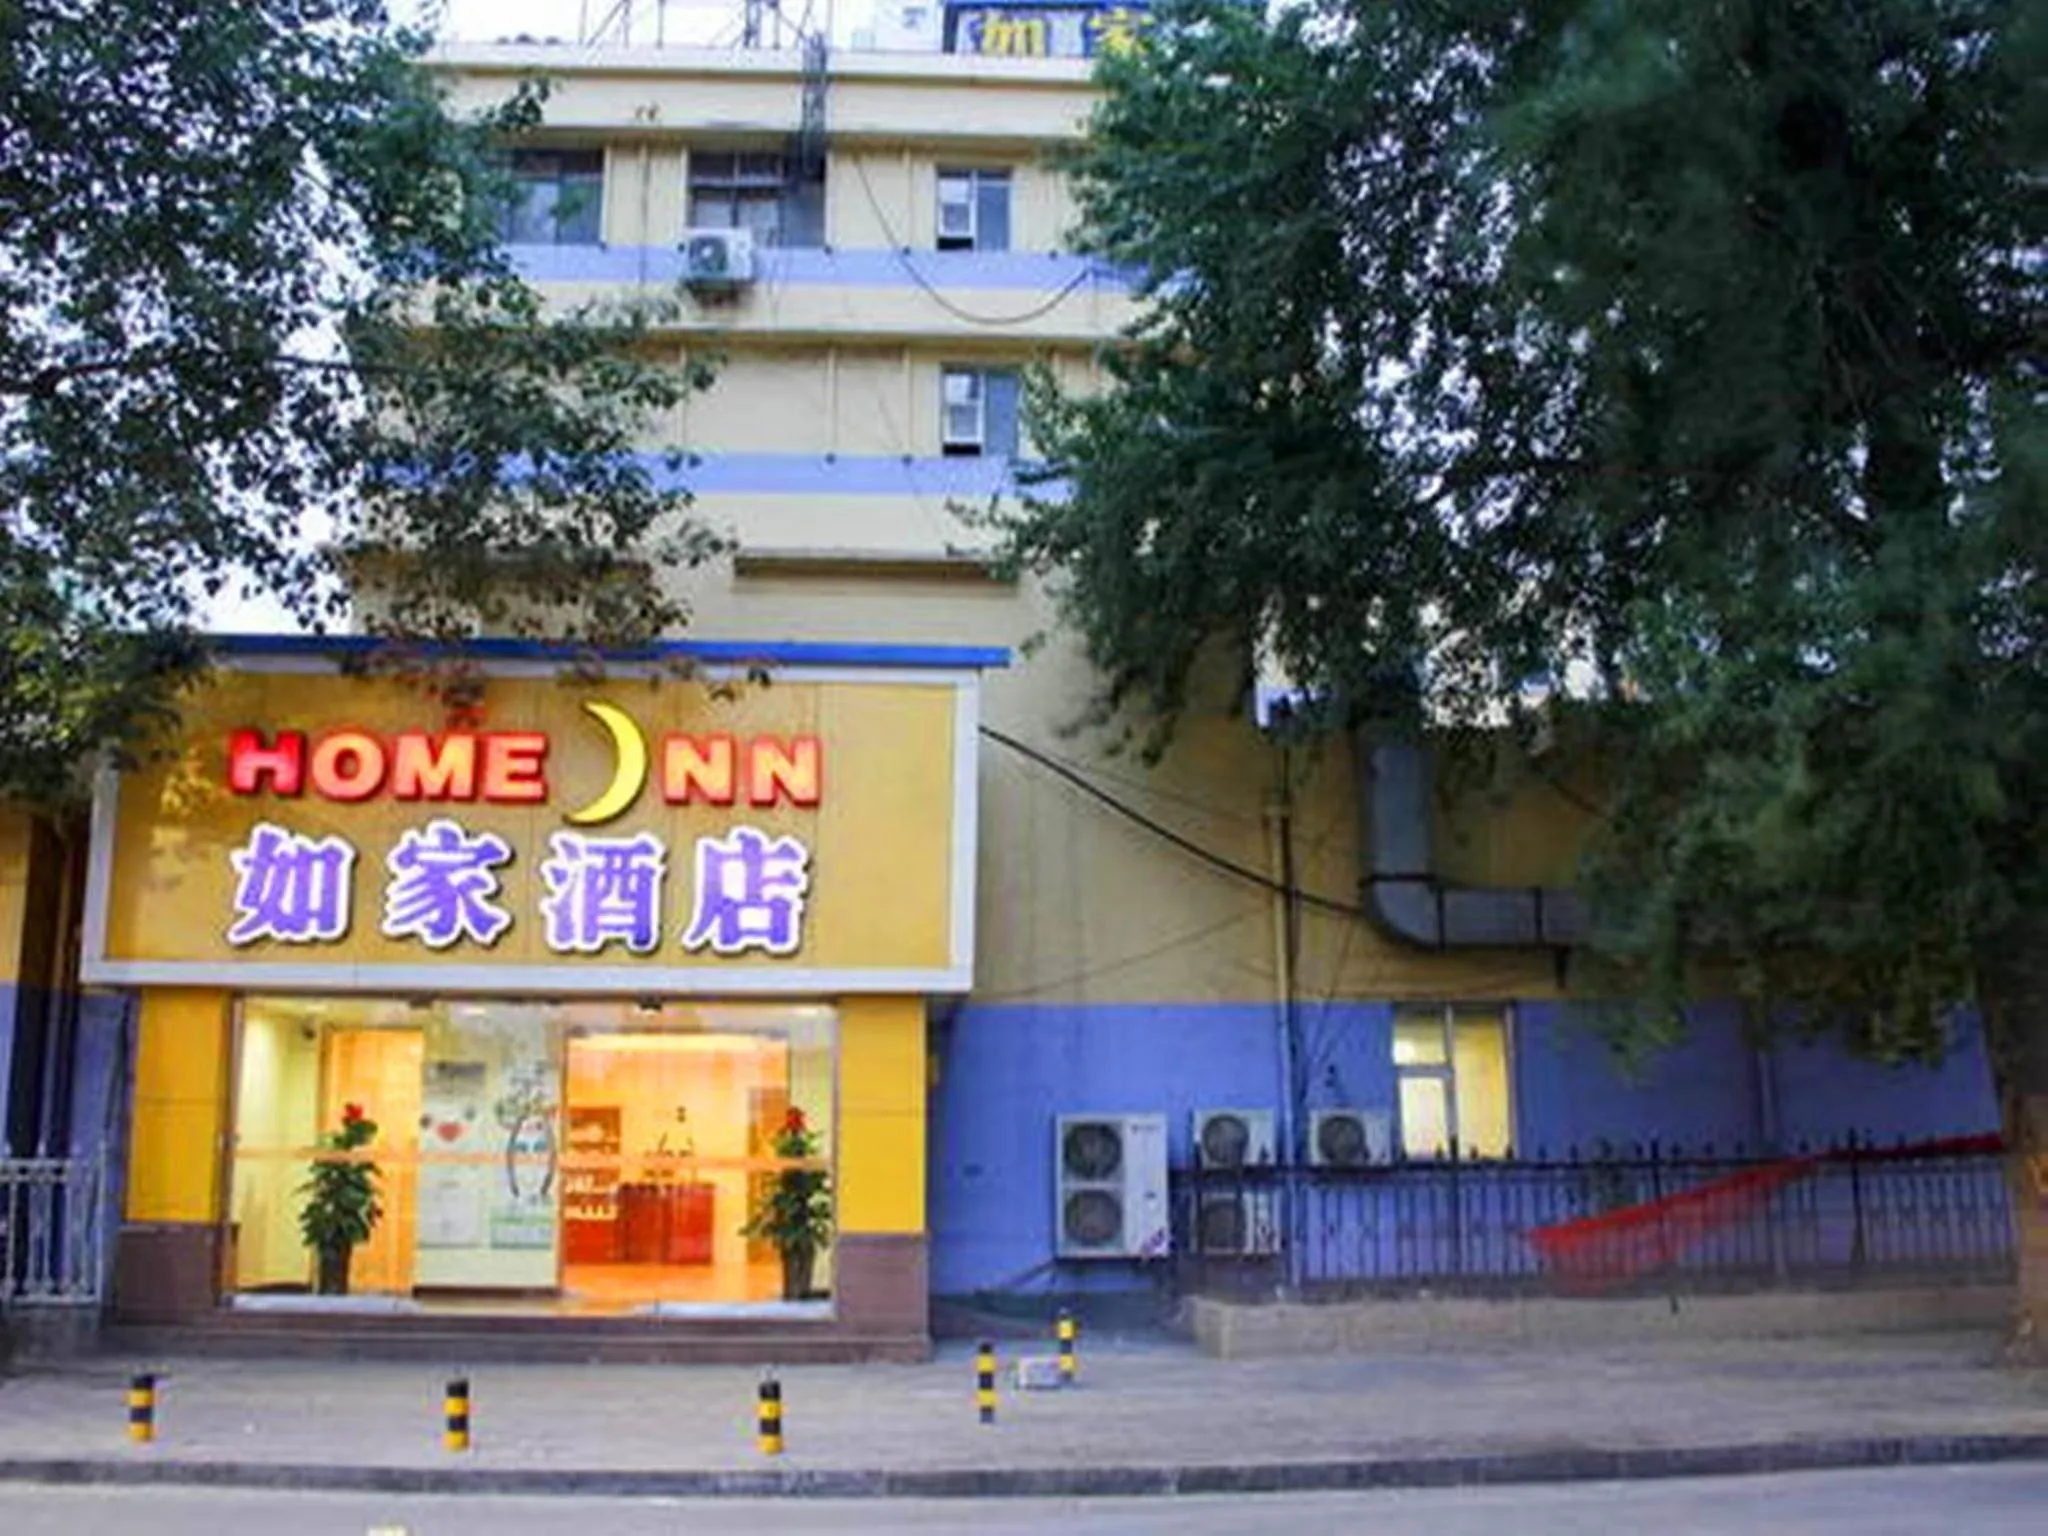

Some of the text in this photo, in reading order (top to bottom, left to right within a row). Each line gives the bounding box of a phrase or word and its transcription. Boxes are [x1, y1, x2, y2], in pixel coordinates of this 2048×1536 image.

[229, 730, 548, 803] HOME
[227, 820, 808, 955] 如家酒店
